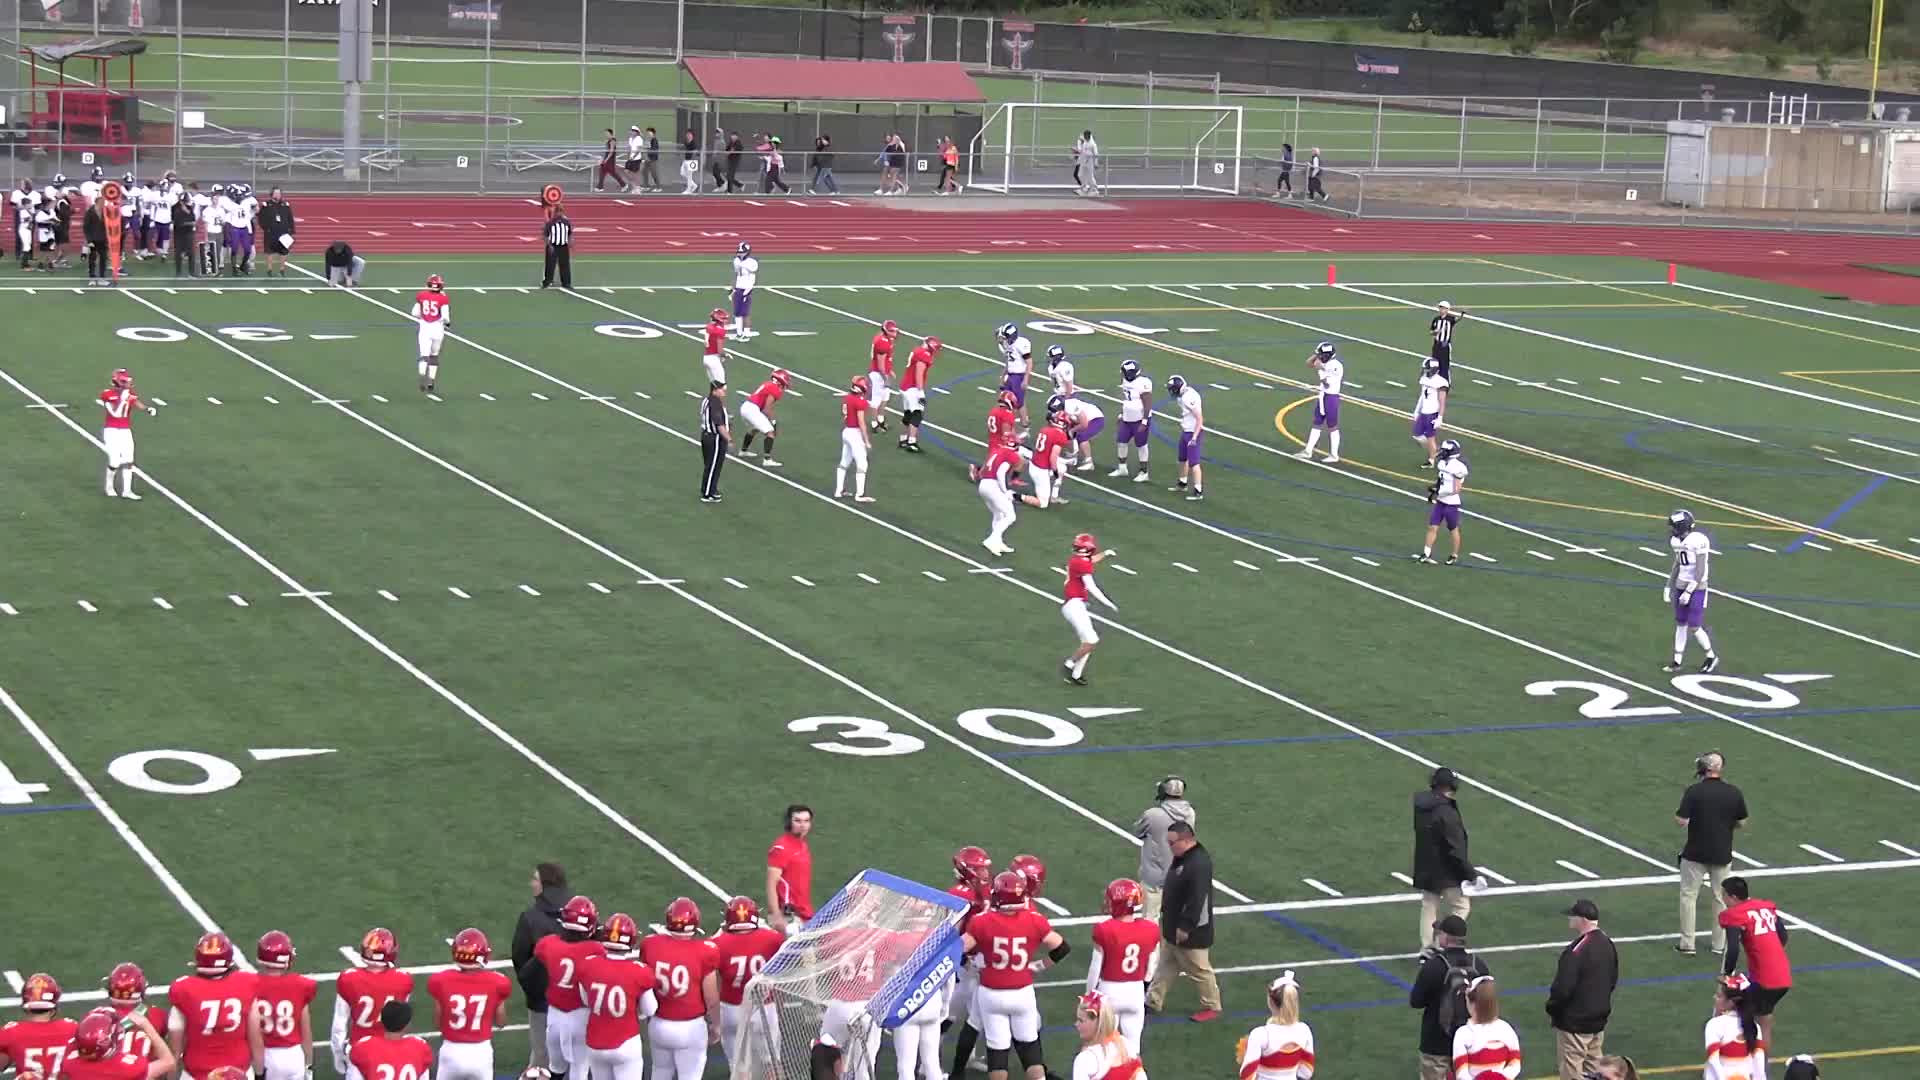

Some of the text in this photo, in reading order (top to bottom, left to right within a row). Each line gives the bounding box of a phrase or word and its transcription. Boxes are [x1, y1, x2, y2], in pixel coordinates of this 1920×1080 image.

[422, 301, 439, 317] 85
[991, 936, 1029, 971] 55
[1121, 943, 1141, 974] 8
[654, 959, 690, 998] 59
[905, 956, 955, 1015] ROGERS
[199, 997, 243, 1036] 73
[448, 994, 489, 1031] 37
[590, 982, 627, 1018] 70
[24, 1046, 67, 1080] 57
